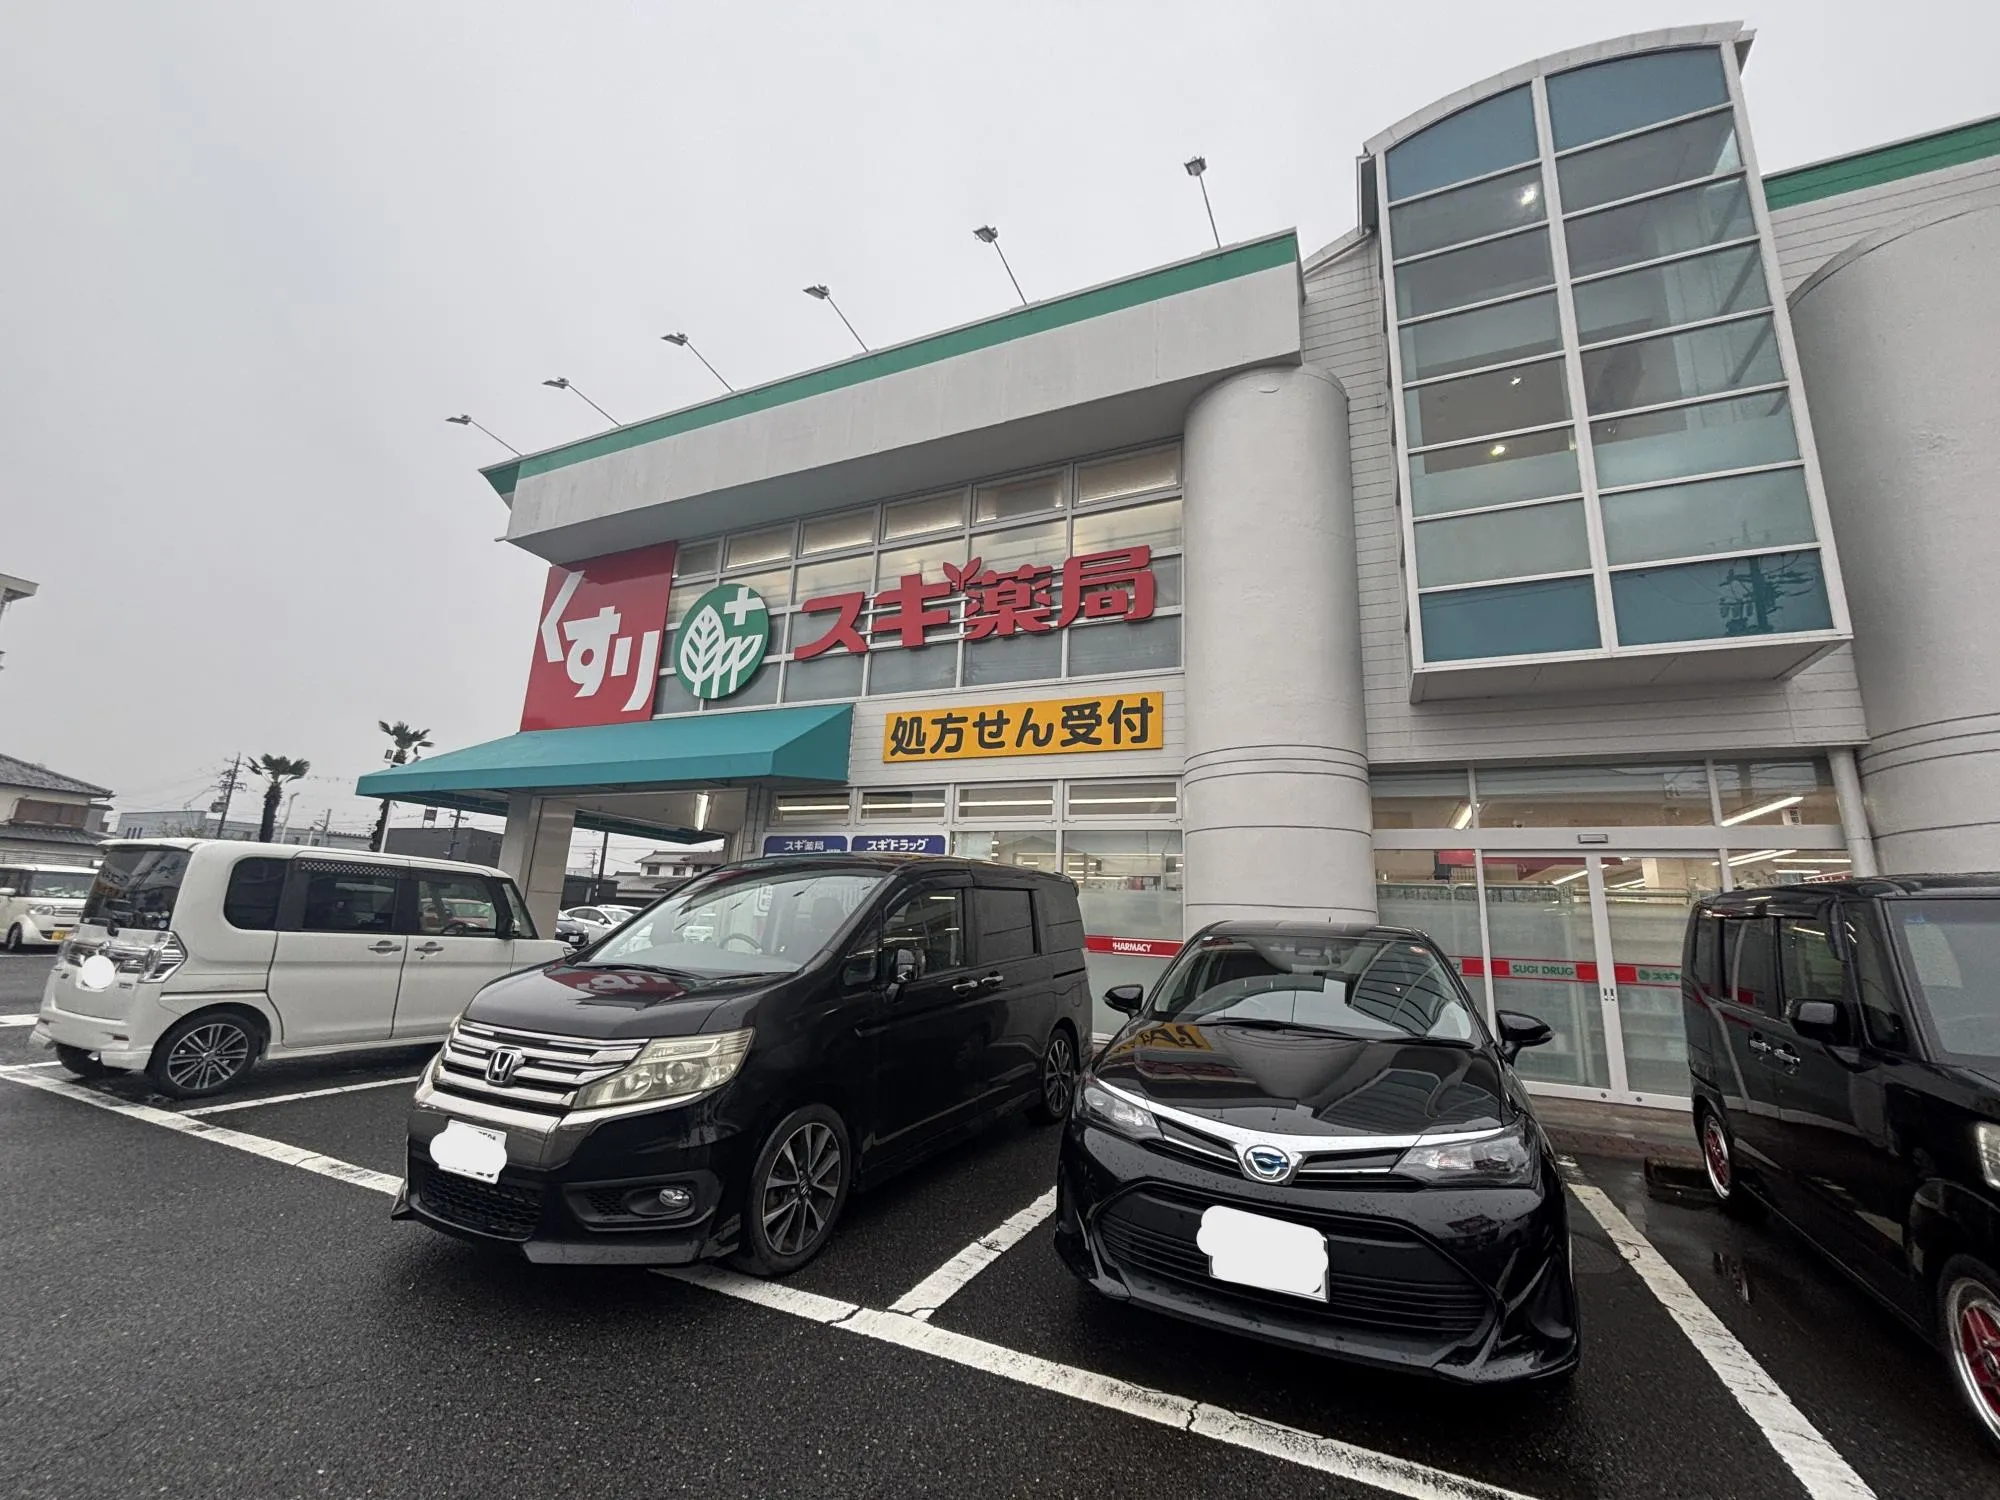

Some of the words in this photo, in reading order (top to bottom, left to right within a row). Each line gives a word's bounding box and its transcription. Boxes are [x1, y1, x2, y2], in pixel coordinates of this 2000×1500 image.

[794, 545, 1155, 660] スギ薬局
[541, 570, 660, 712] くすり
[890, 697, 1153, 757] 処方せん受付
[784, 839, 824, 851] スギ薬局
[866, 838, 929, 851] スギドラッグ
[1512, 963, 1540, 974] SUGI
[1542, 965, 1574, 976] DRUG
